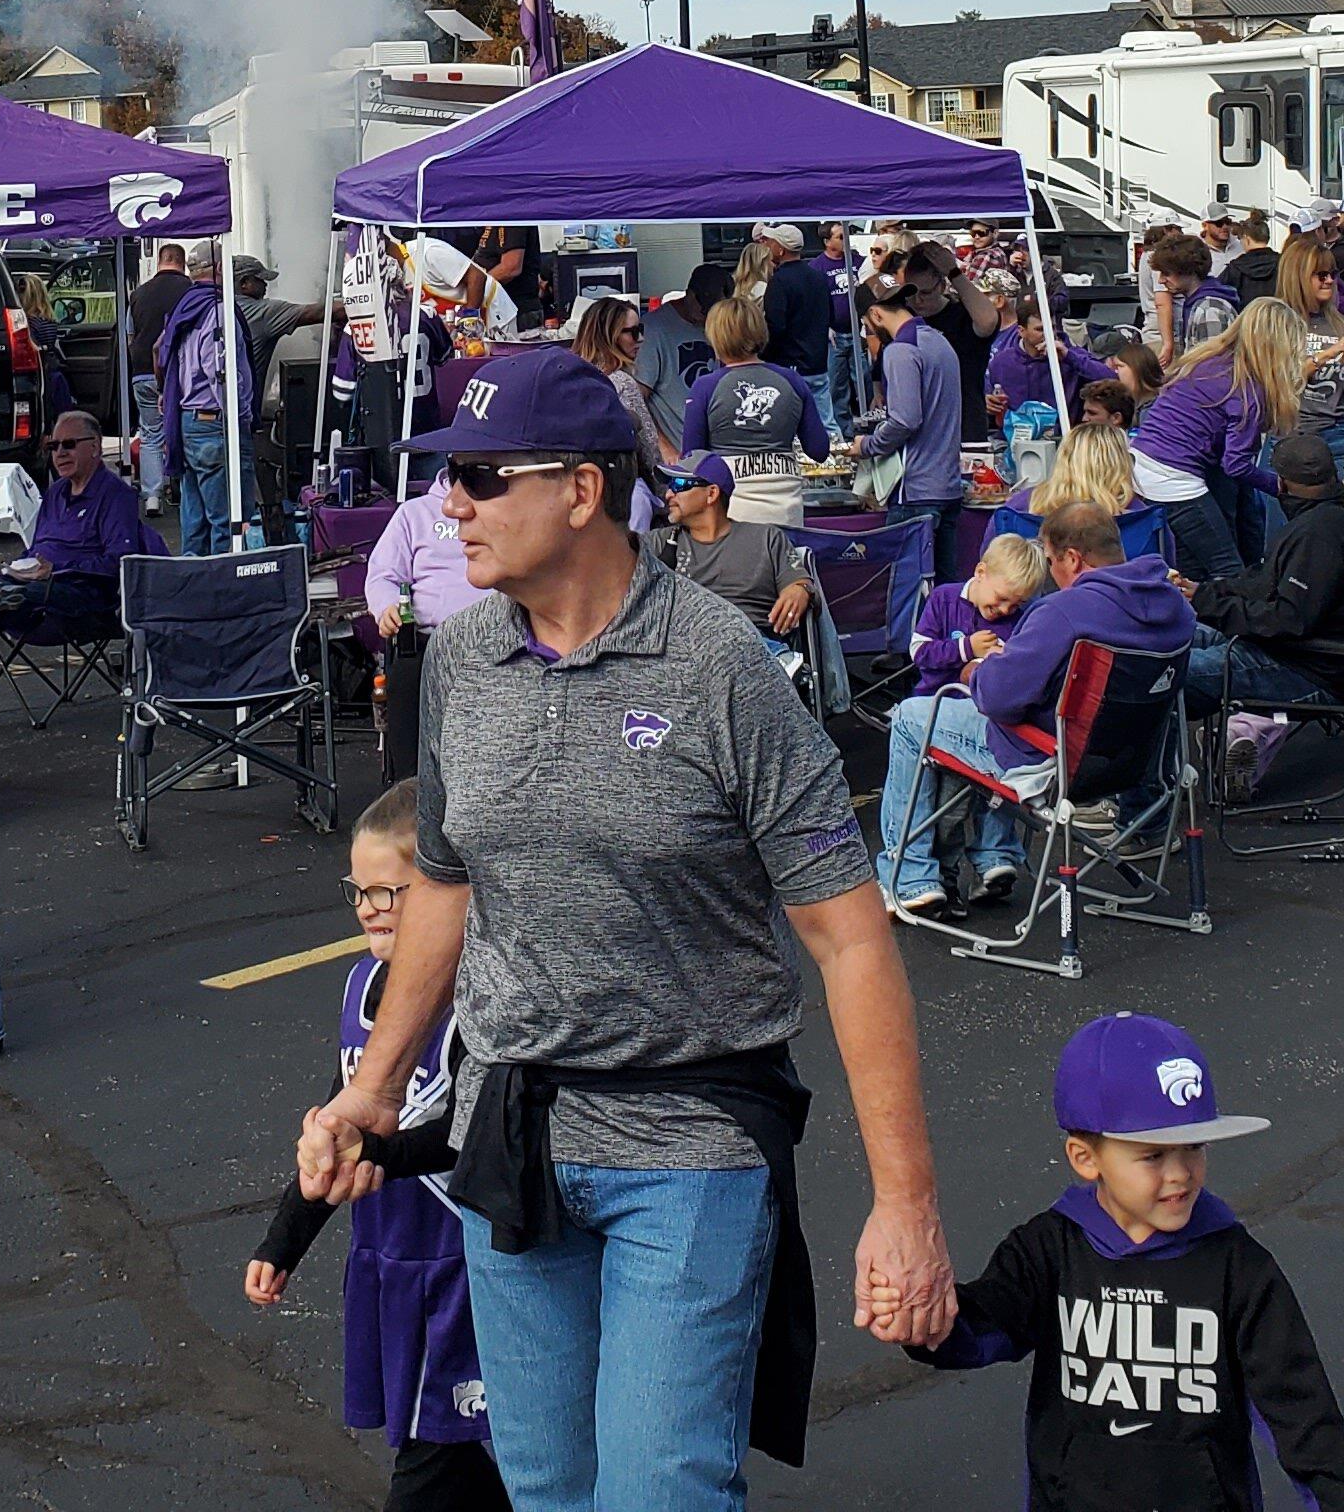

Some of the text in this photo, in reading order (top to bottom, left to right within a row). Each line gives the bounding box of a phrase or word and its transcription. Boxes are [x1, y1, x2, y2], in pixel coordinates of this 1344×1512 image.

[734, 454, 774, 480] KANSAS
[1100, 1286, 1168, 1305] K-STATE
[1058, 1294, 1219, 1365] WILD
[1061, 1355, 1218, 1414] CATS
